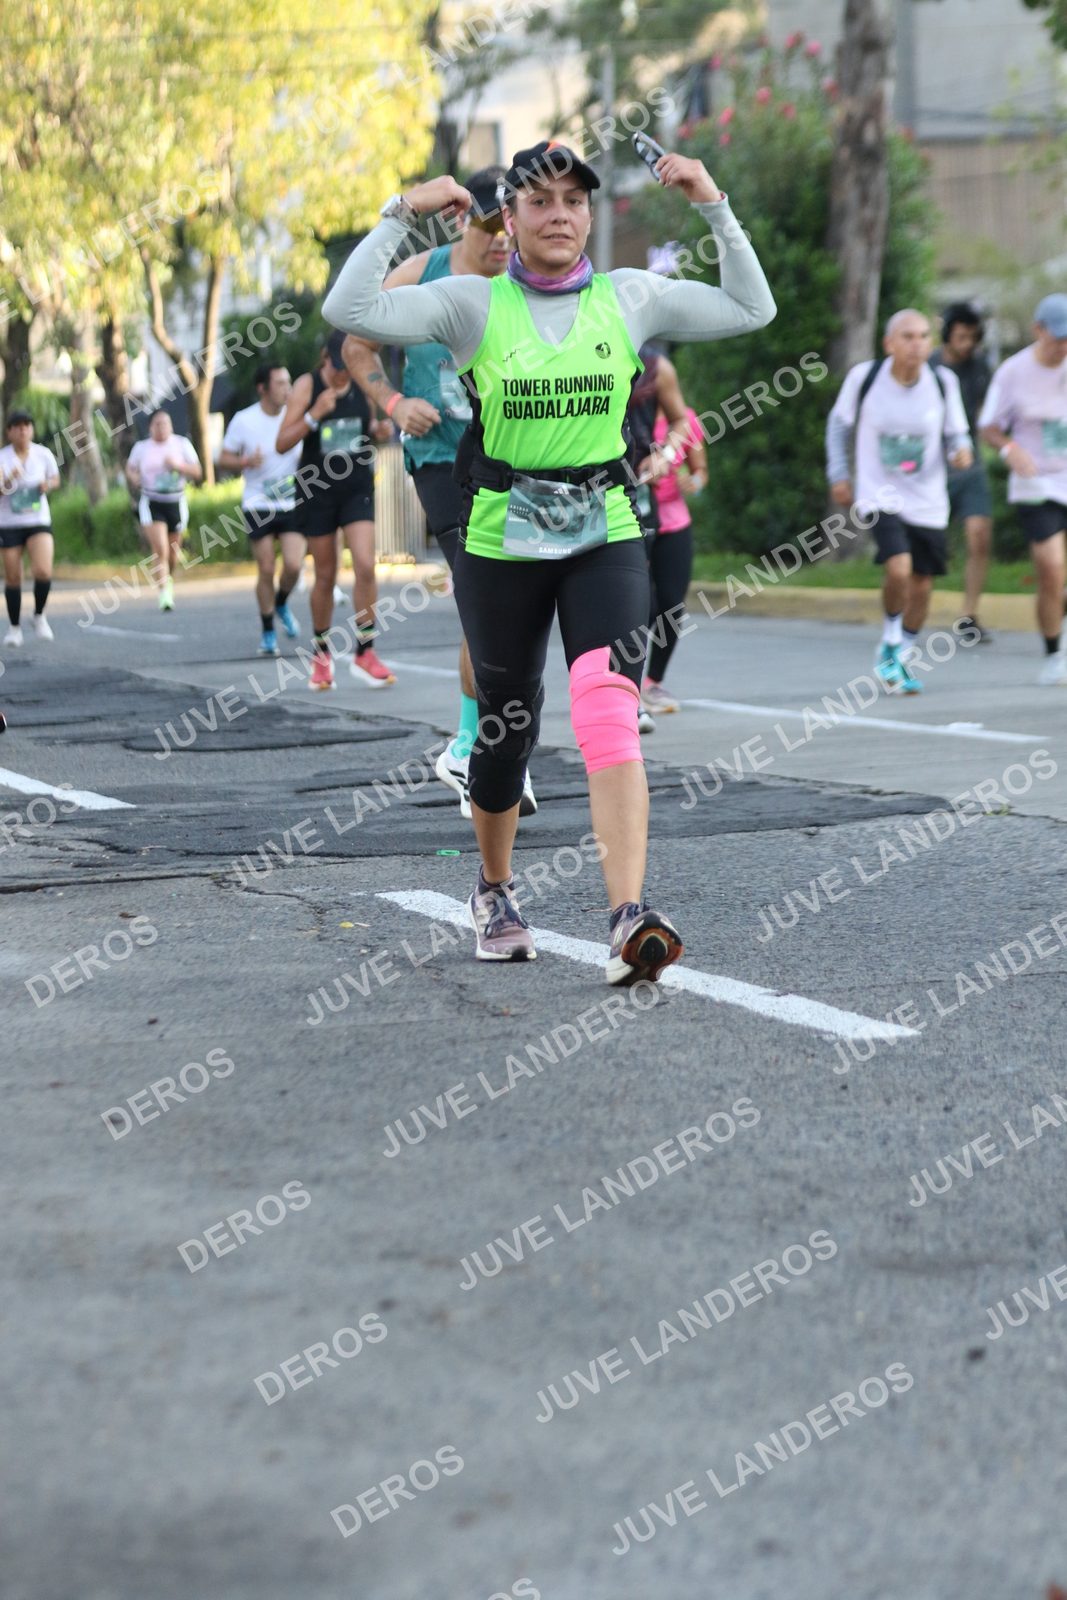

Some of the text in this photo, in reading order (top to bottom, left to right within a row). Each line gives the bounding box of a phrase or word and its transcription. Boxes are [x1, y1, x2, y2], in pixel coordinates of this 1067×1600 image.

[502, 374, 614, 396] TOWER RUNNING
[503, 396, 610, 420] GUADALAJARA
